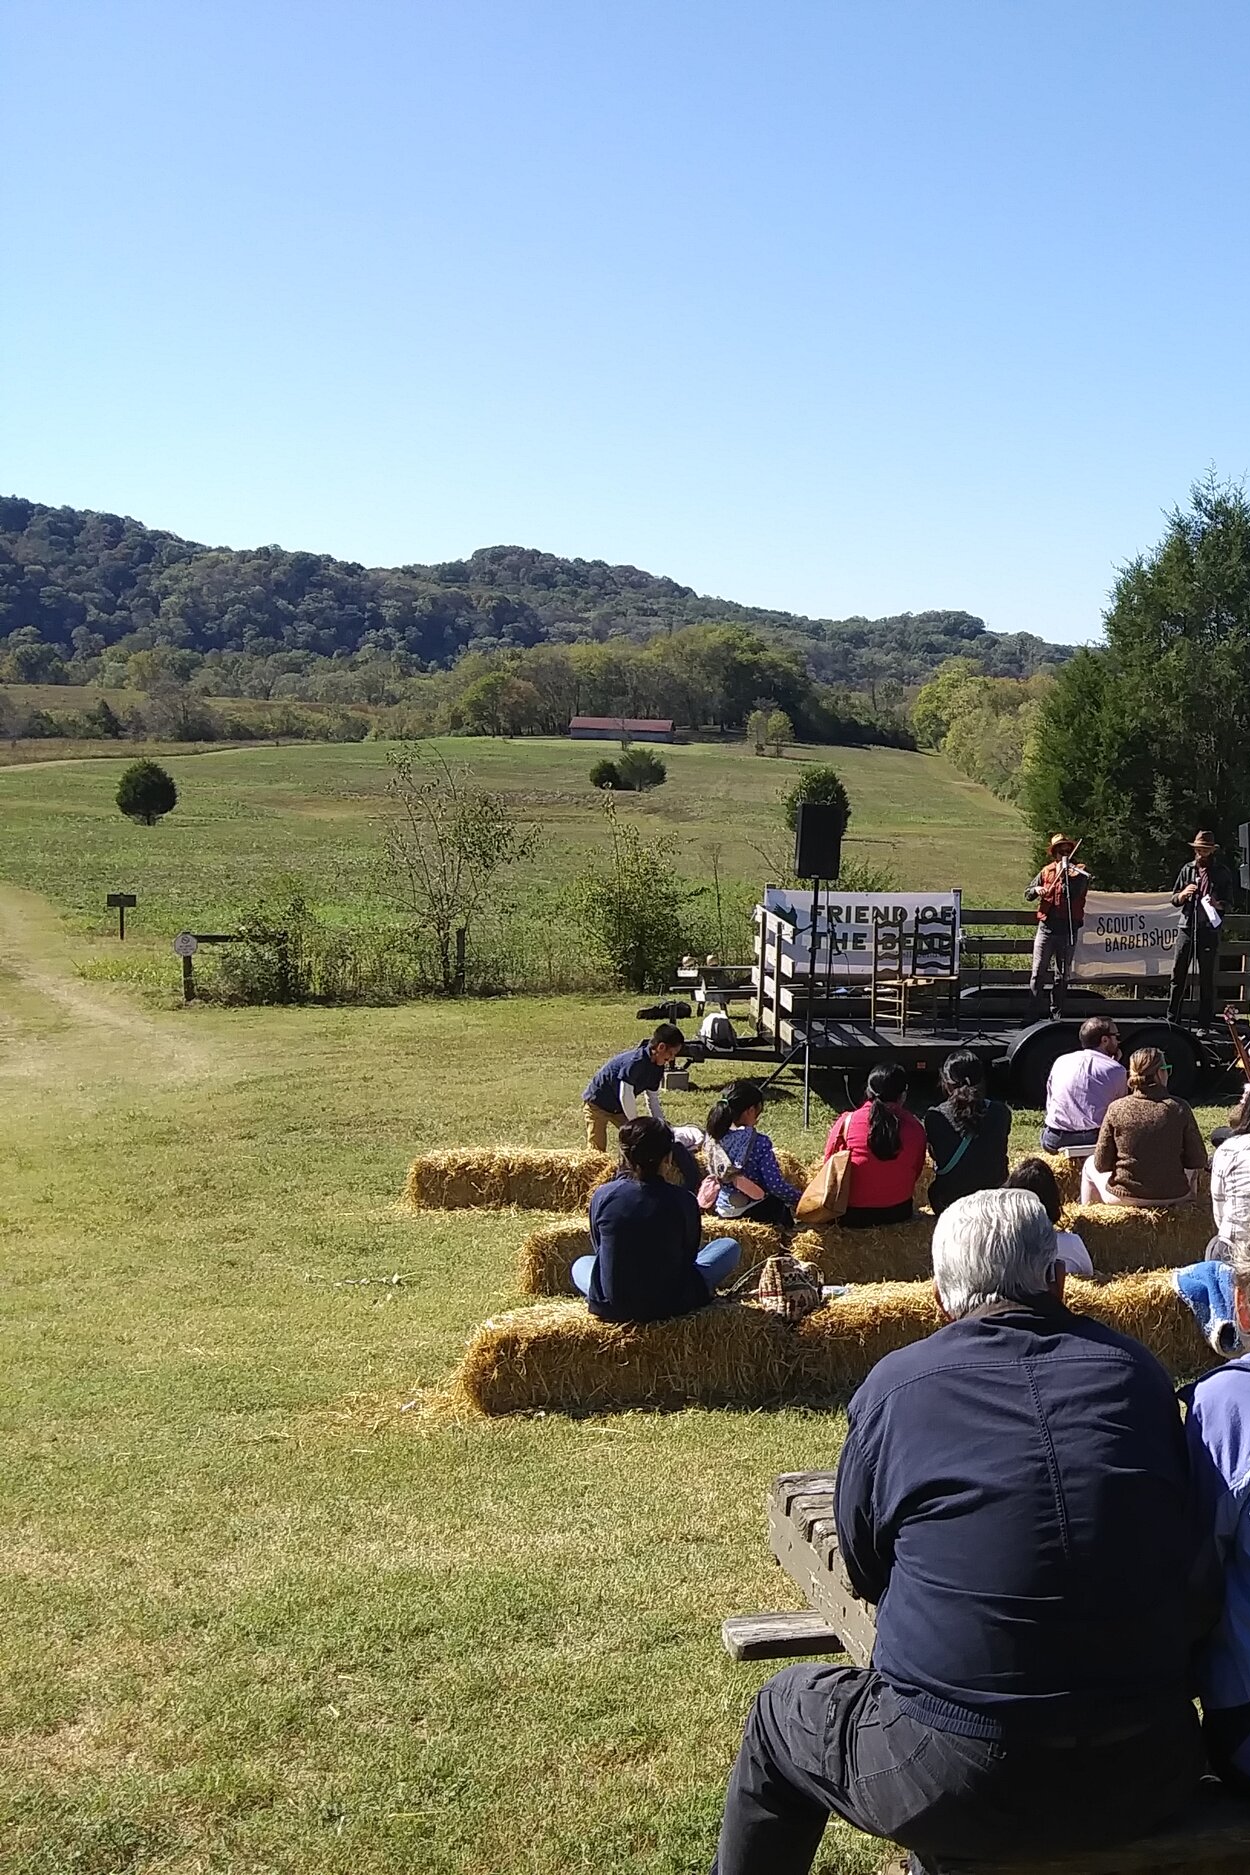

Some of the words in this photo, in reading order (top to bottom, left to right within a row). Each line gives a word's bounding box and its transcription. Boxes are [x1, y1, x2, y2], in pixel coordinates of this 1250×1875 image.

[810, 905, 908, 923] FRIEND
[1097, 914, 1146, 936] SCOUT'S
[811, 932, 868, 950] THE
[1105, 928, 1178, 952] BARBERSHOP
